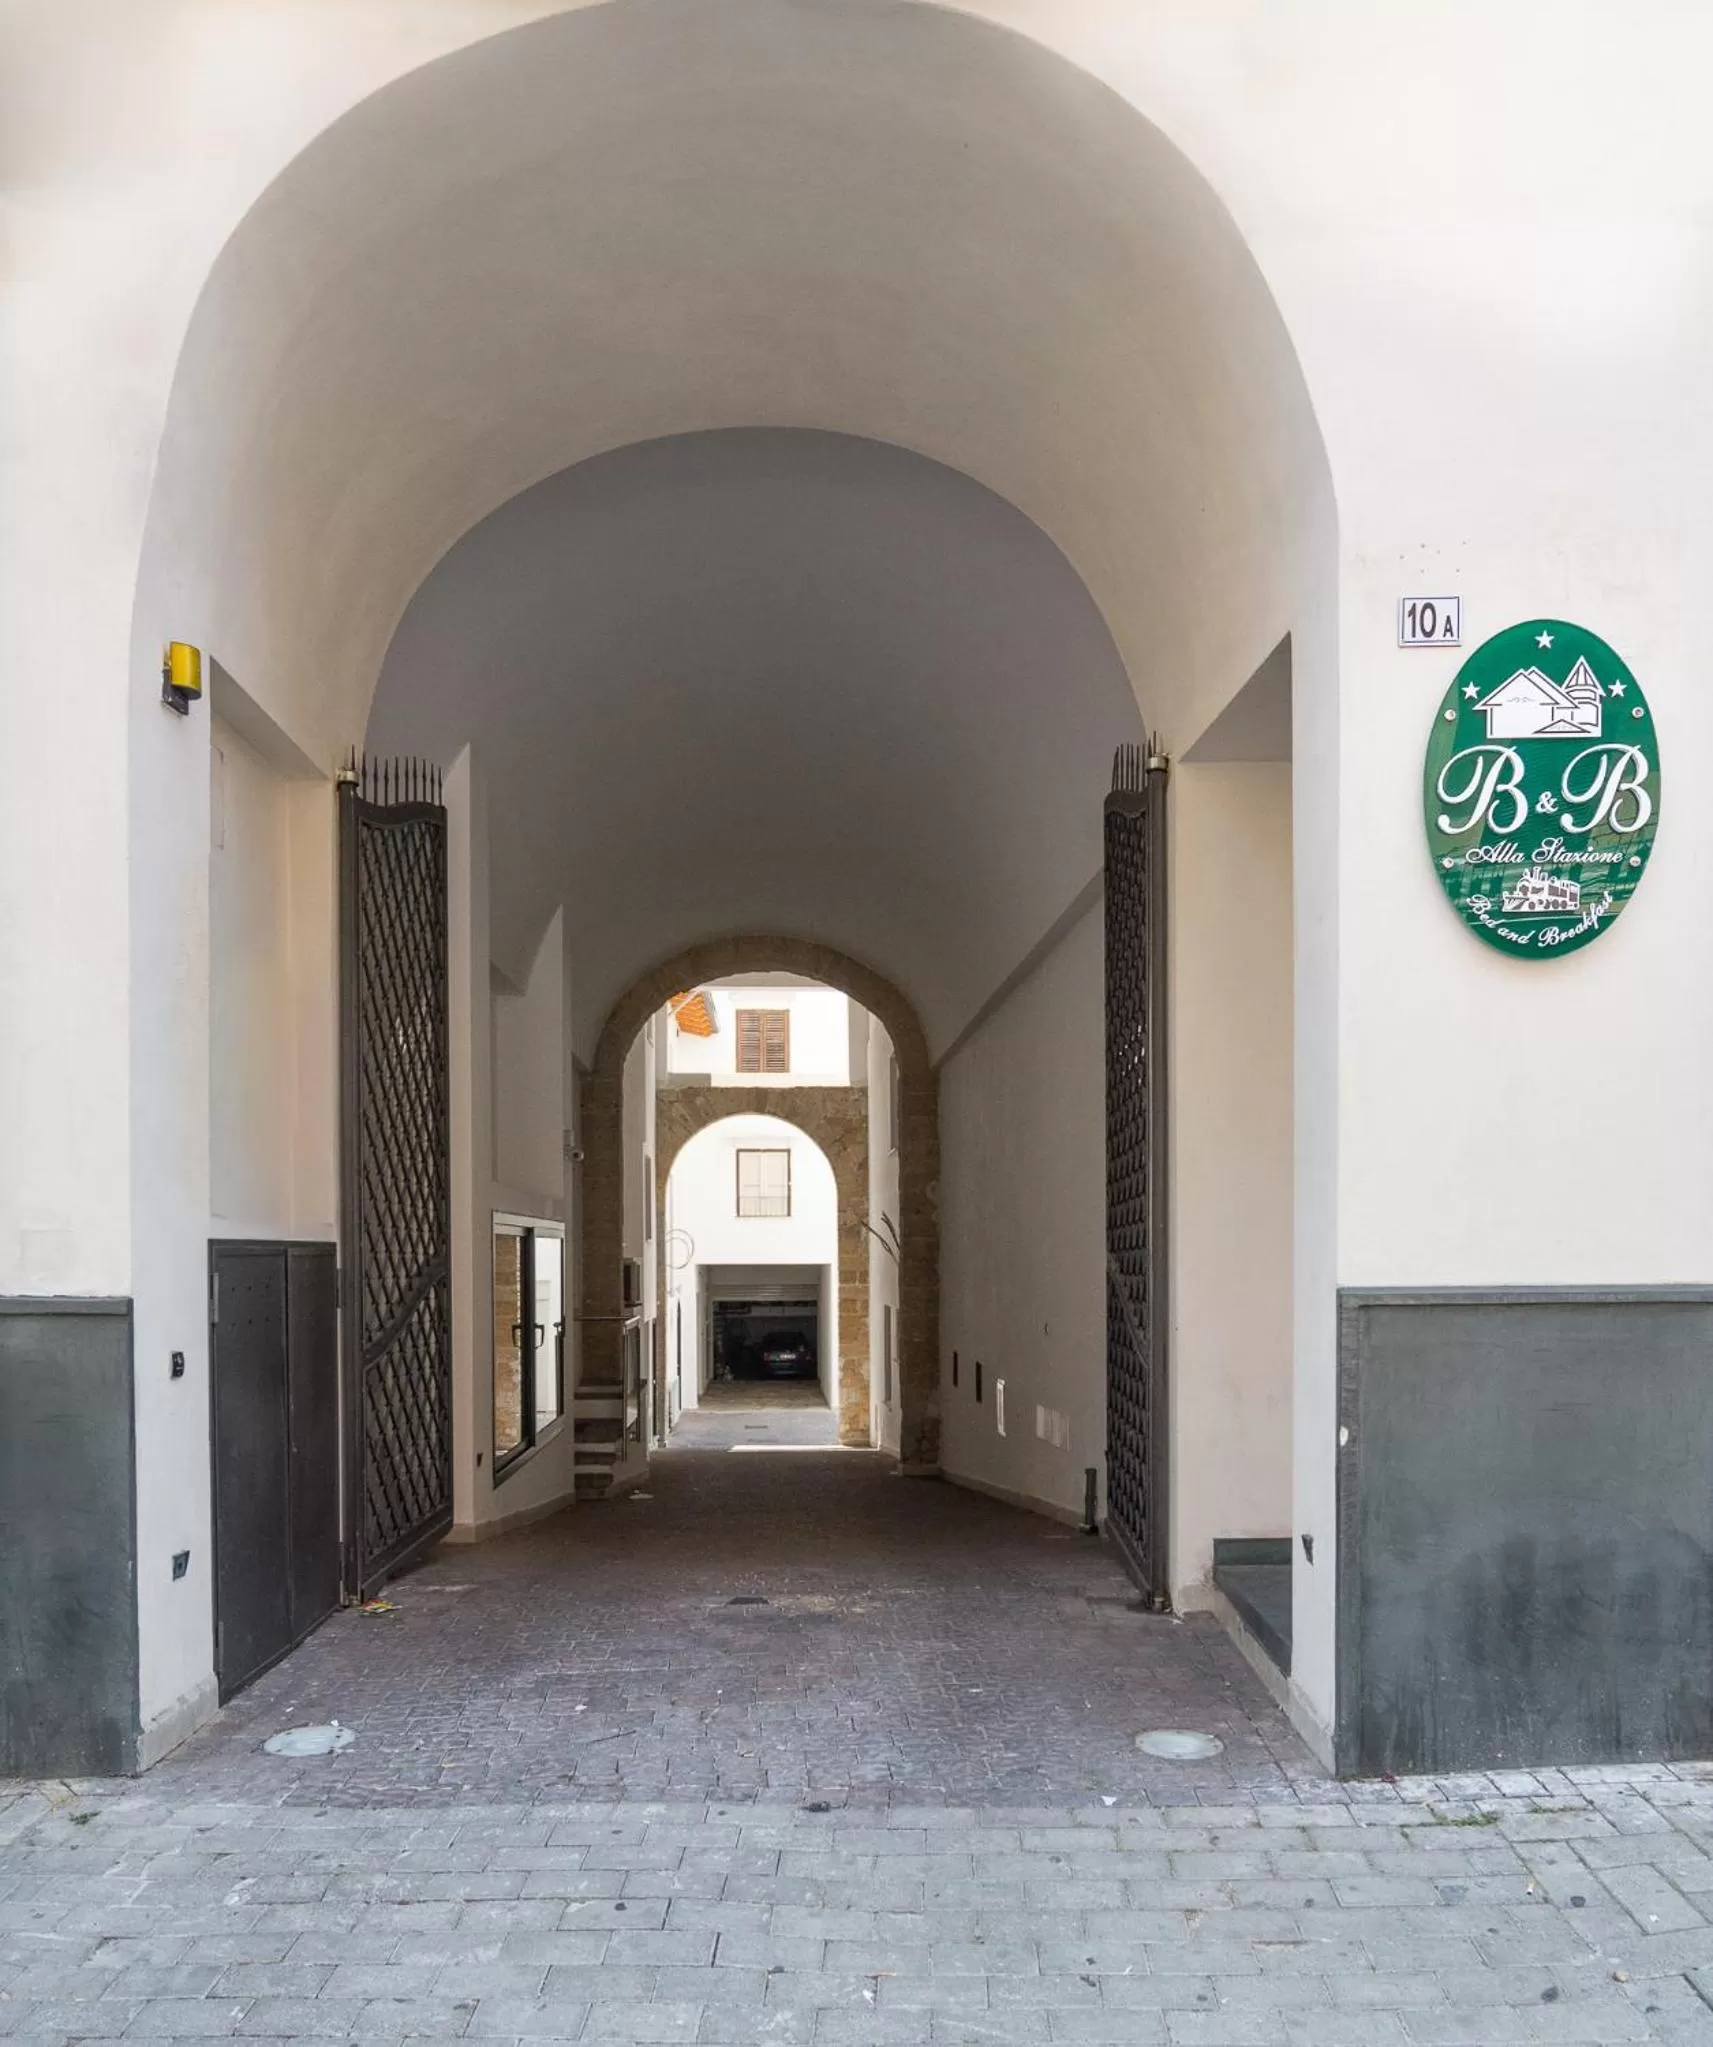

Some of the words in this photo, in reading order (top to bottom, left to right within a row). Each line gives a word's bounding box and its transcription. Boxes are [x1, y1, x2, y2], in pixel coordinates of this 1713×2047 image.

[1437, 745, 1528, 834] B
[1535, 791, 1560, 814] &
[1560, 744, 1653, 834] B
[1466, 839, 1525, 864] Alla
[1531, 836, 1623, 864] Stazione
[1466, 894, 1499, 928] Bed
[1497, 926, 1536, 945] and
[1538, 890, 1613, 948] Breakfast
